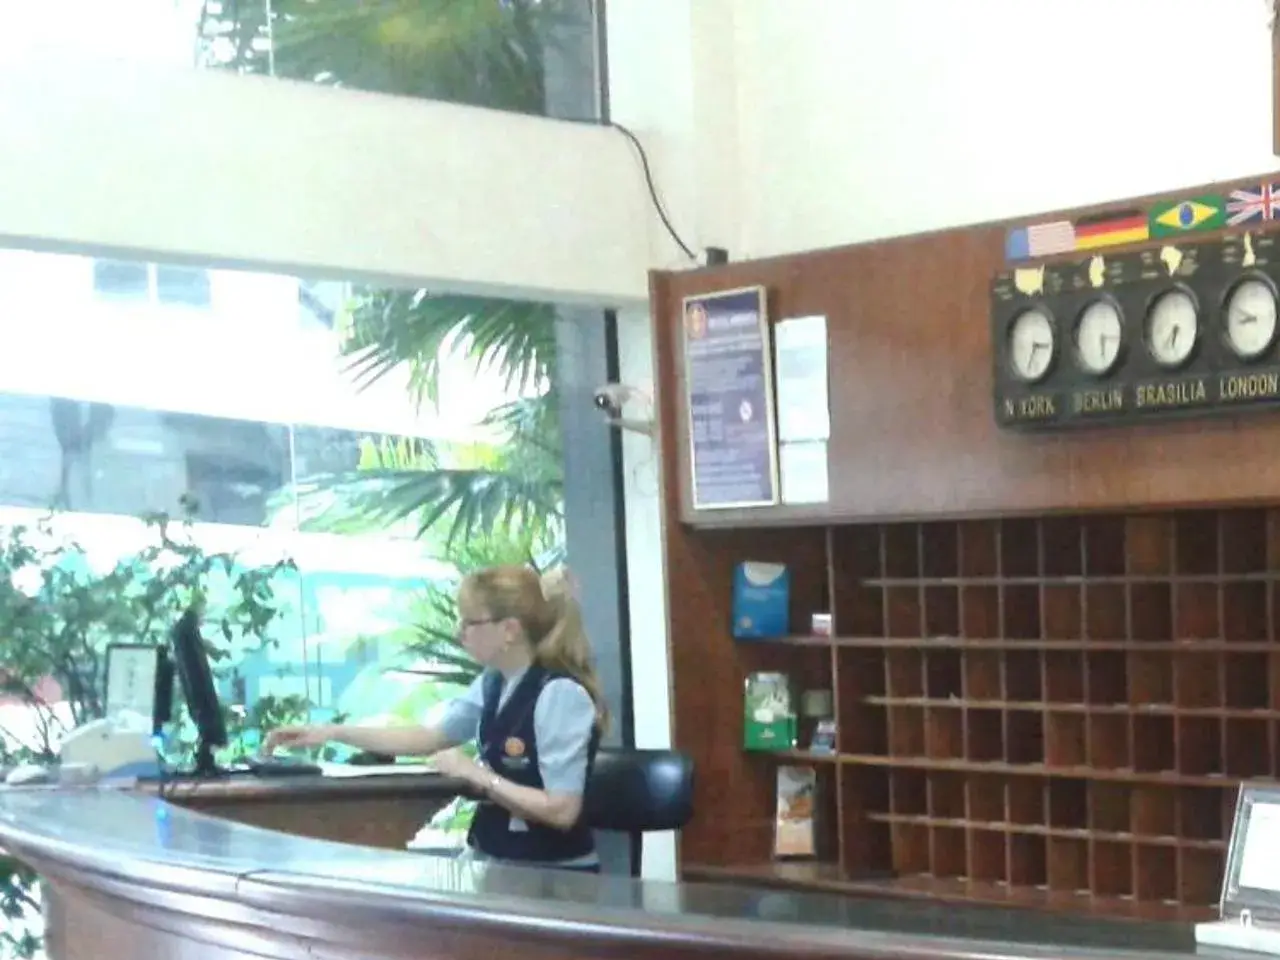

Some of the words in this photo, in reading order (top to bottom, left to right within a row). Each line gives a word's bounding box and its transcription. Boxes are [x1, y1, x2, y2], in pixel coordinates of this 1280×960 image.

[1136, 380, 1206, 407] BRASILIA
[1219, 374, 1278, 398] LONDON
[1021, 395, 1055, 417] YORK
[1075, 389, 1123, 412] BERLIN
